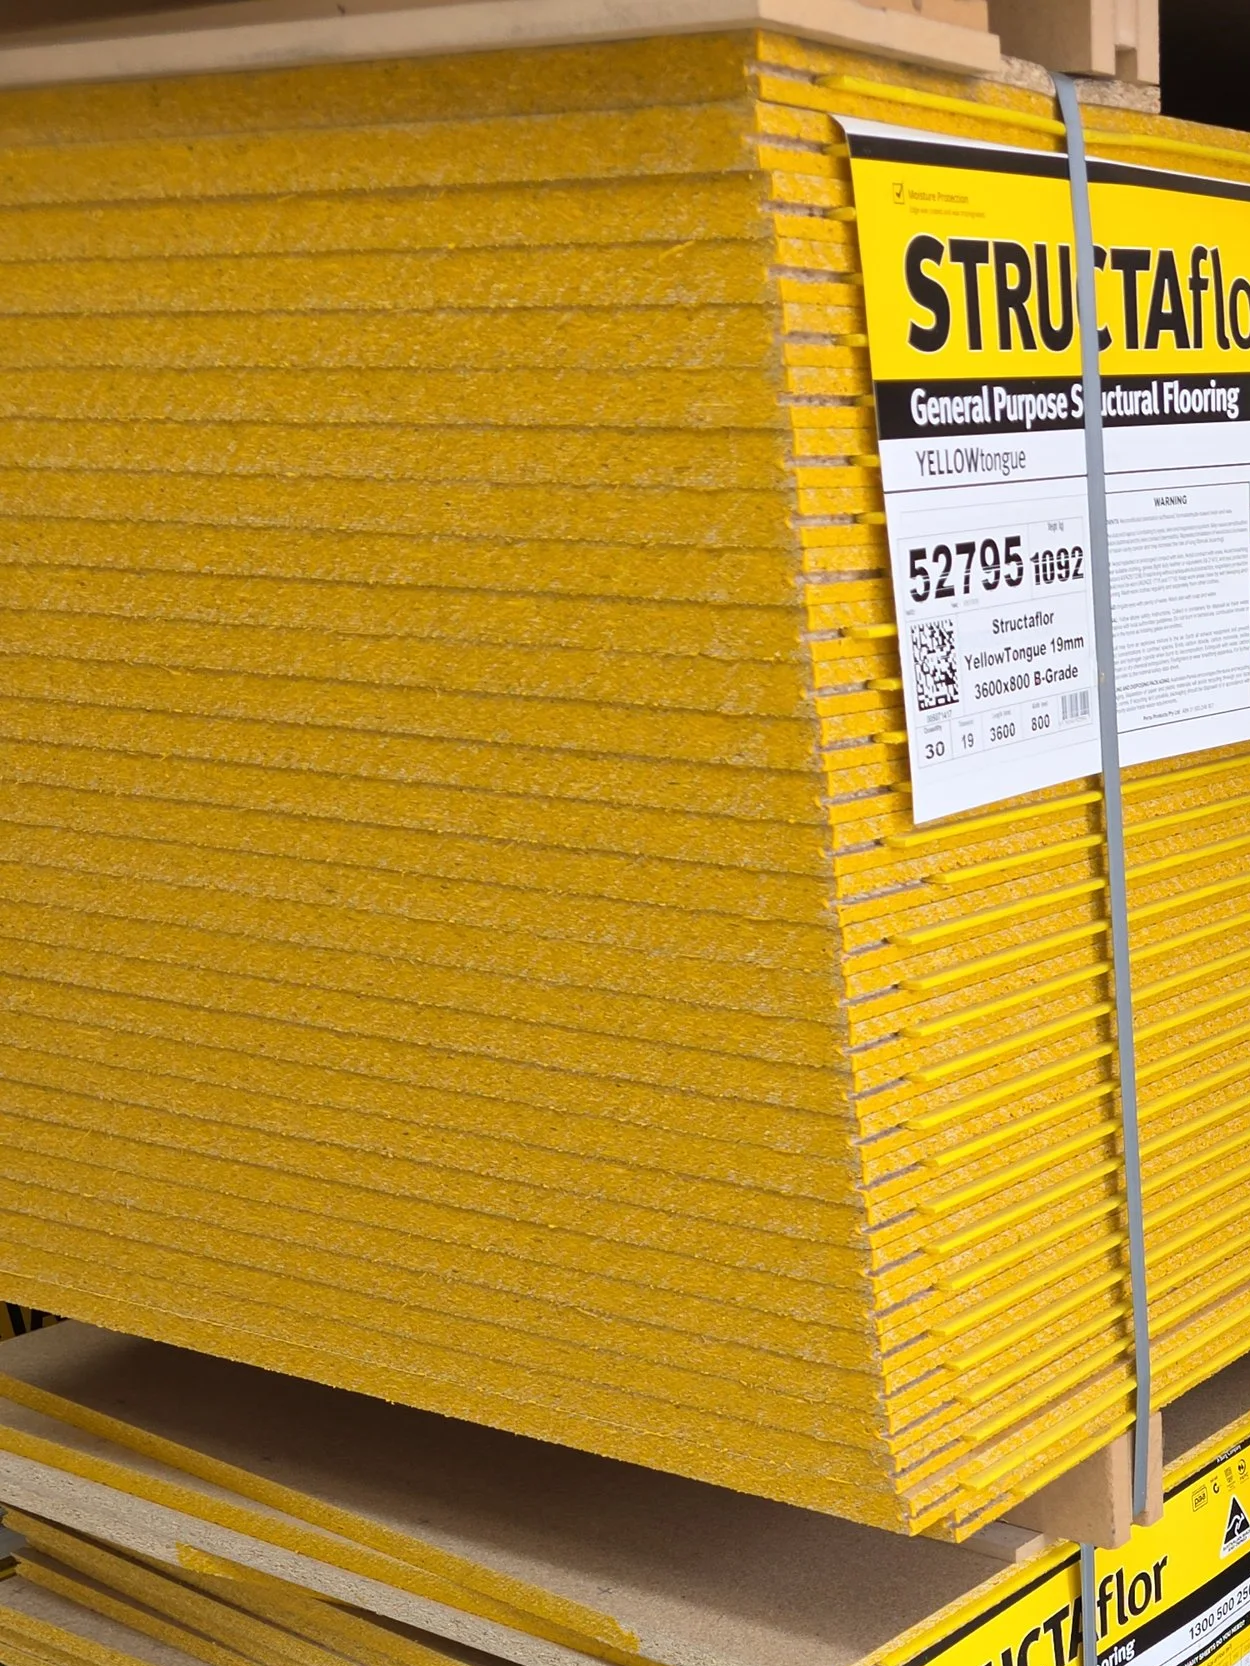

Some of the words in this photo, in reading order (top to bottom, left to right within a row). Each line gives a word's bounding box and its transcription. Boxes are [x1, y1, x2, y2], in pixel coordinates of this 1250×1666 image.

[910, 385, 991, 426] General
[993, 386, 1068, 429] Purpose
[1071, 380, 1160, 418] Sctural
[1163, 379, 1240, 419] Flooring
[916, 447, 1026, 476] YELLOWtongue
[1154, 495, 1188, 507] WARNING
[909, 535, 1024, 603] 52795
[1030, 546, 1084, 586] 1092
[992, 611, 1055, 634] Structaflor
[964, 642, 1047, 671] YellowTongue
[1050, 636, 1085, 653] 19mm
[974, 673, 1030, 700] 3600x800
[1034, 664, 1079, 686] B-Grade
[925, 741, 945, 760] 30
[962, 733, 974, 750] 19
[990, 722, 1016, 742] 3600
[1032, 714, 1050, 732] 800
[1188, 1613, 1214, 1640] 1300
[1216, 1597, 1234, 1620] 500
